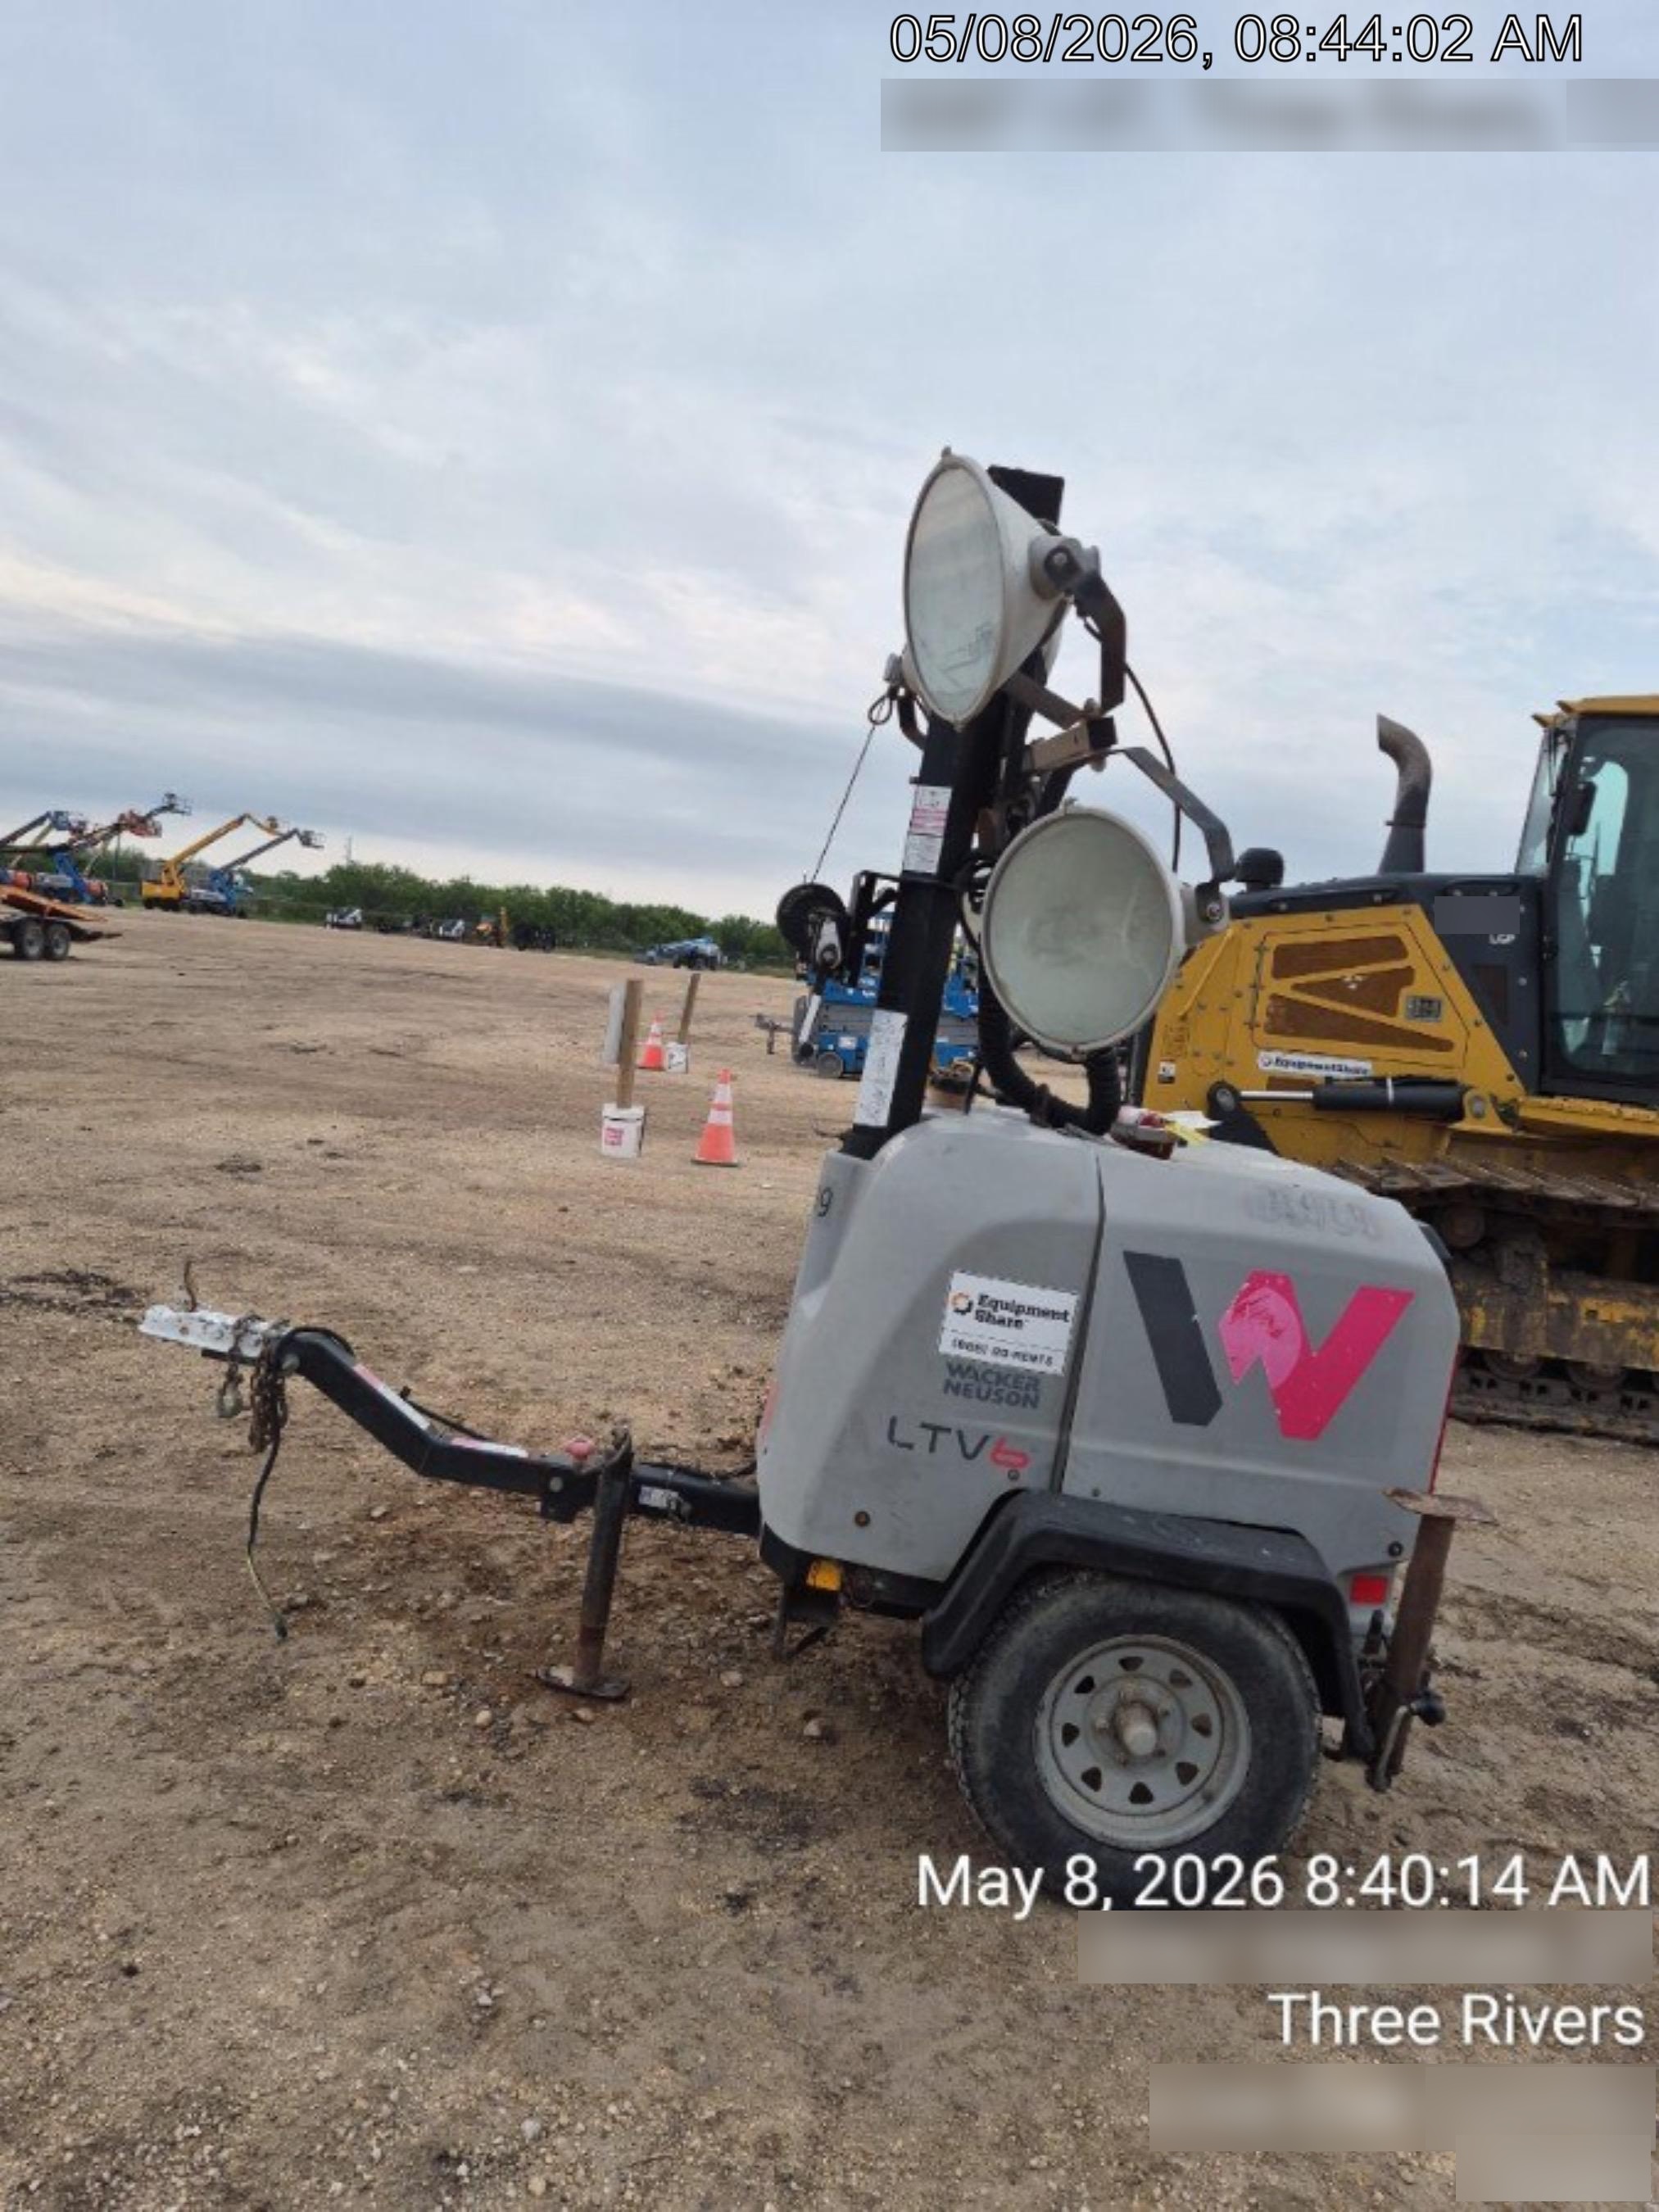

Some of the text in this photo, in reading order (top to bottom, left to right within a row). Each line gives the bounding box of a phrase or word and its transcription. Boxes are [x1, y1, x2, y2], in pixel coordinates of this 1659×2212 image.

[974, 1309, 1024, 1330] Share
[977, 1293, 1071, 1323] Equipment
[945, 1360, 1041, 1393] WACKER
[943, 1377, 1040, 1410] NEUSON
[887, 1415, 1031, 1469] LTV6
